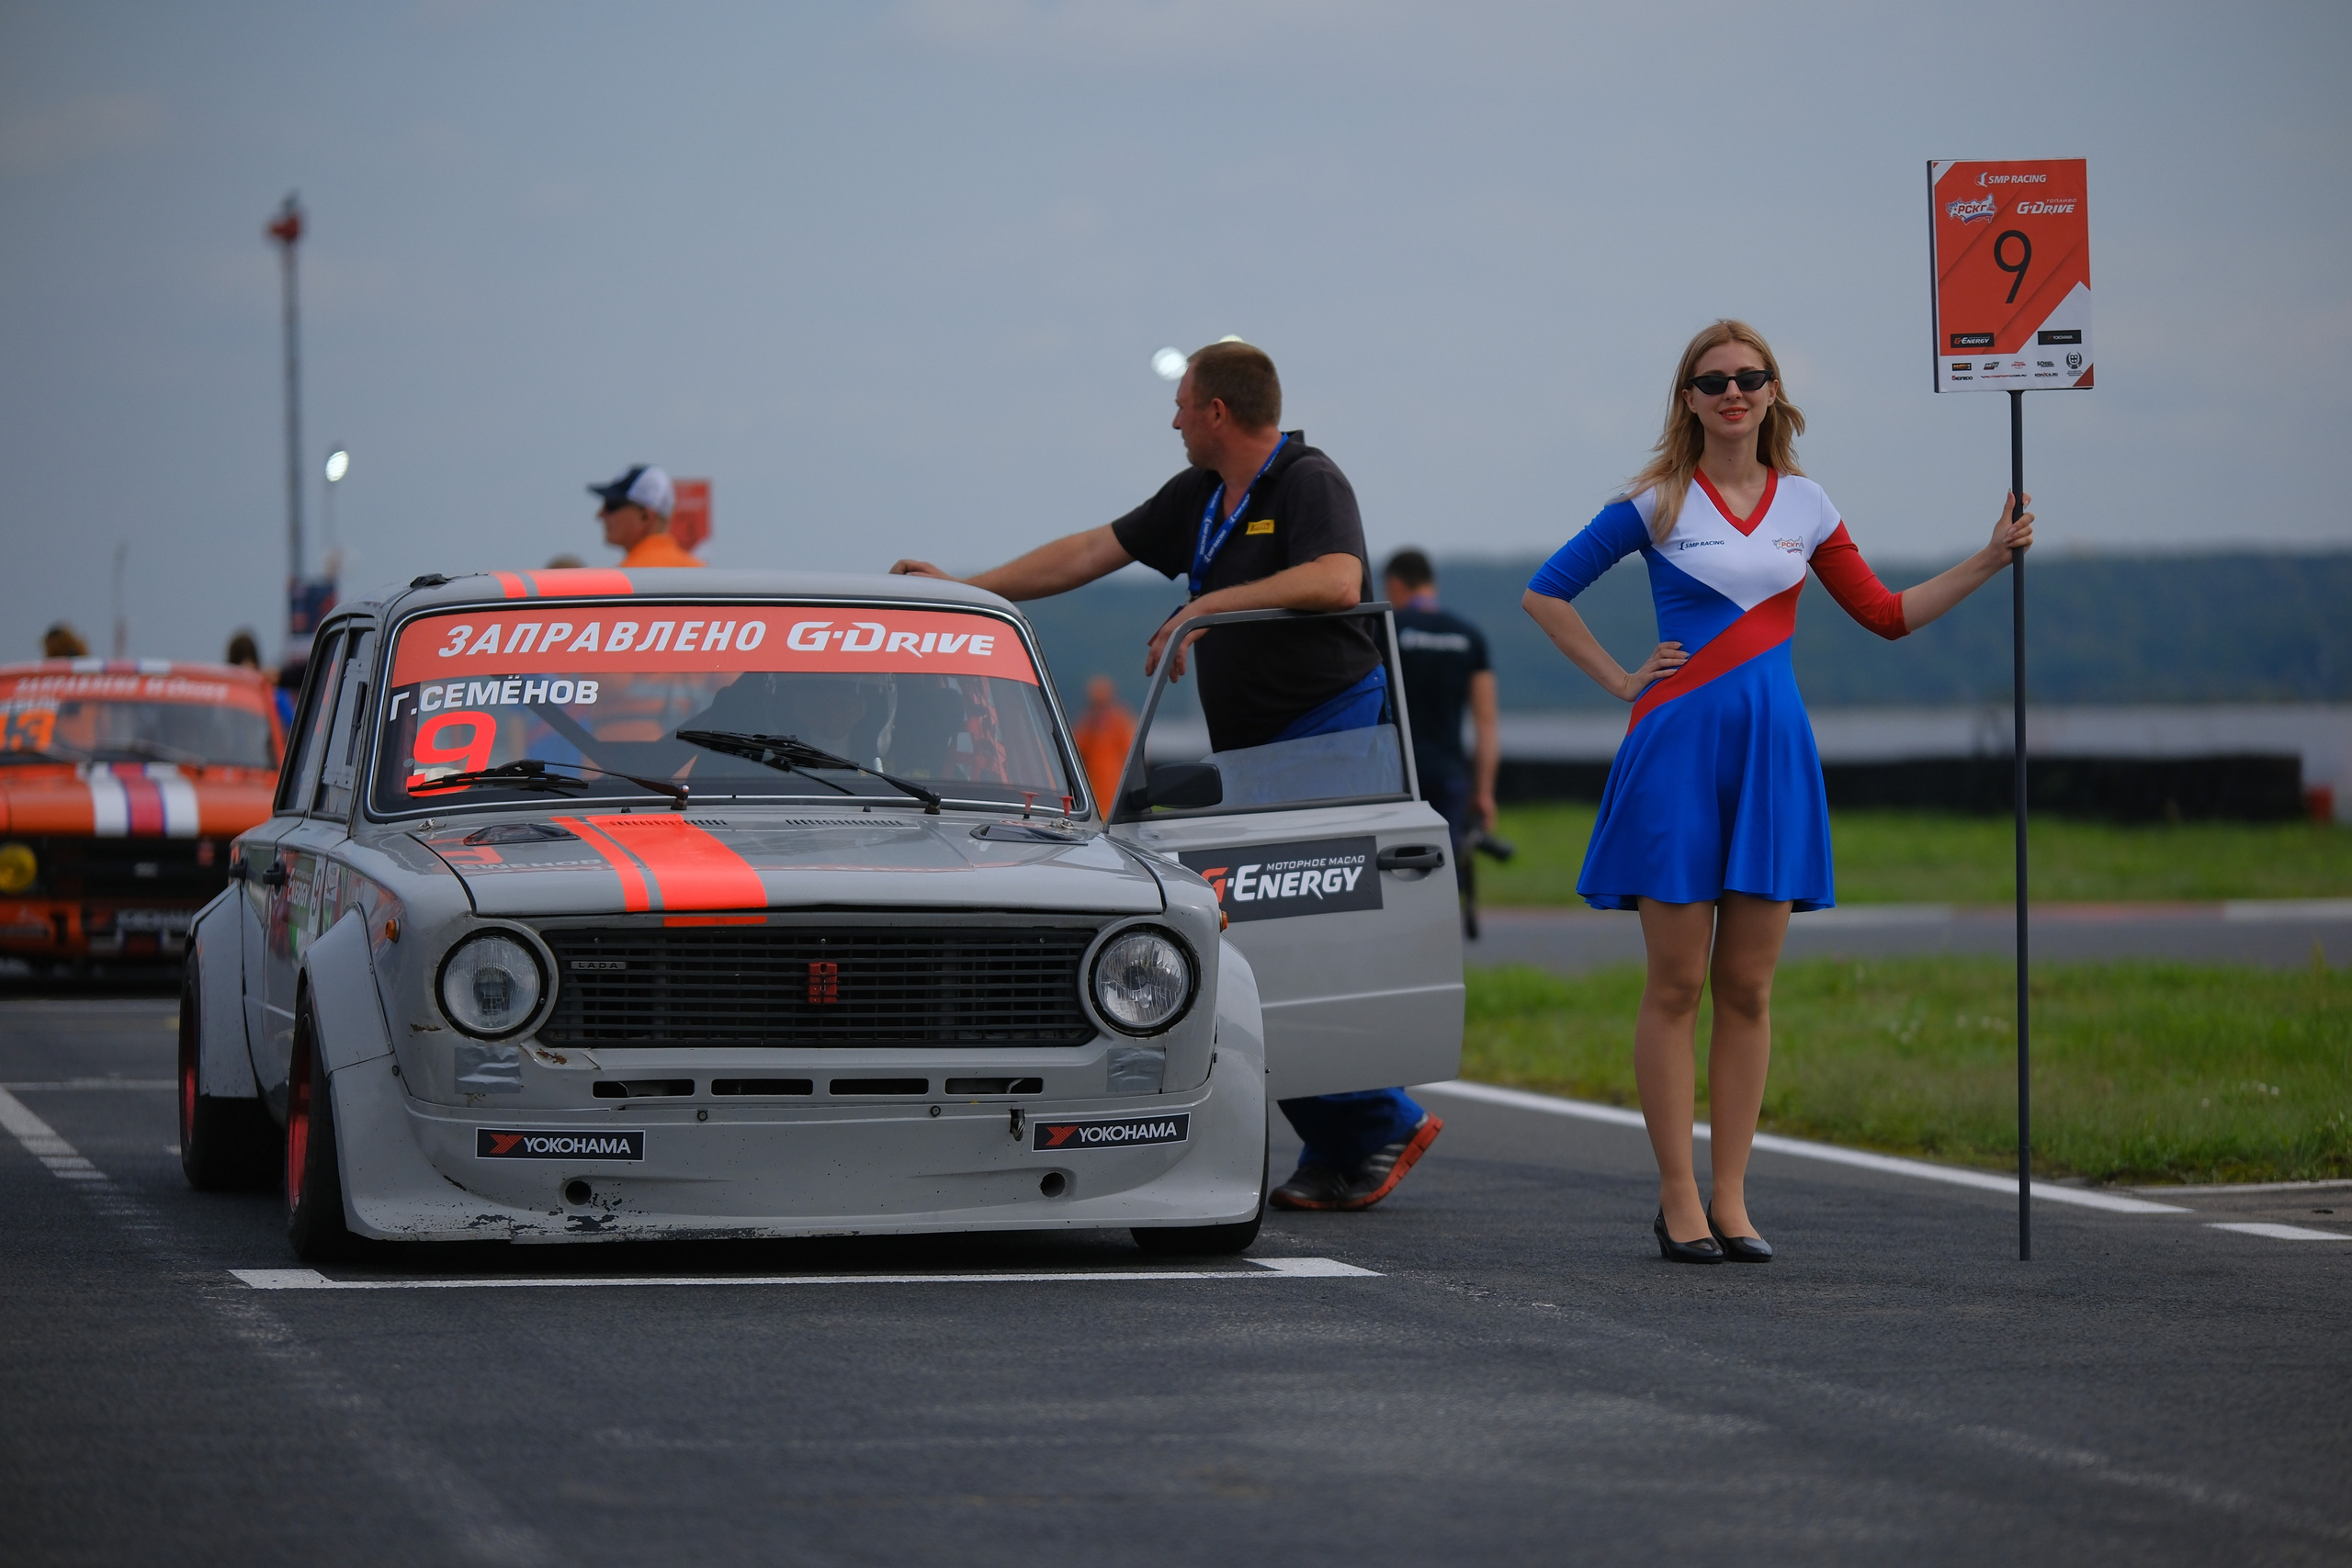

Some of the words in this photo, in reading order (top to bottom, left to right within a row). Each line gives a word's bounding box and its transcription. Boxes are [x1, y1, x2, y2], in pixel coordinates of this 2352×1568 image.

[1988, 175, 2009, 184] SMP
[2011, 175, 2047, 183] RACING
[1994, 230, 2032, 304] 9
[1684, 541, 1700, 549] SMP
[438, 621, 766, 658] ЗАПРАВЛЕНО
[406, 710, 496, 797] 9
[1266, 858, 1327, 872] МОТОРНОЕ
[1329, 854, 1365, 865] МАСЛО
[1078, 1122, 1178, 1143] YOKOHAMA
[523, 1137, 631, 1154] YOKOHAMA
